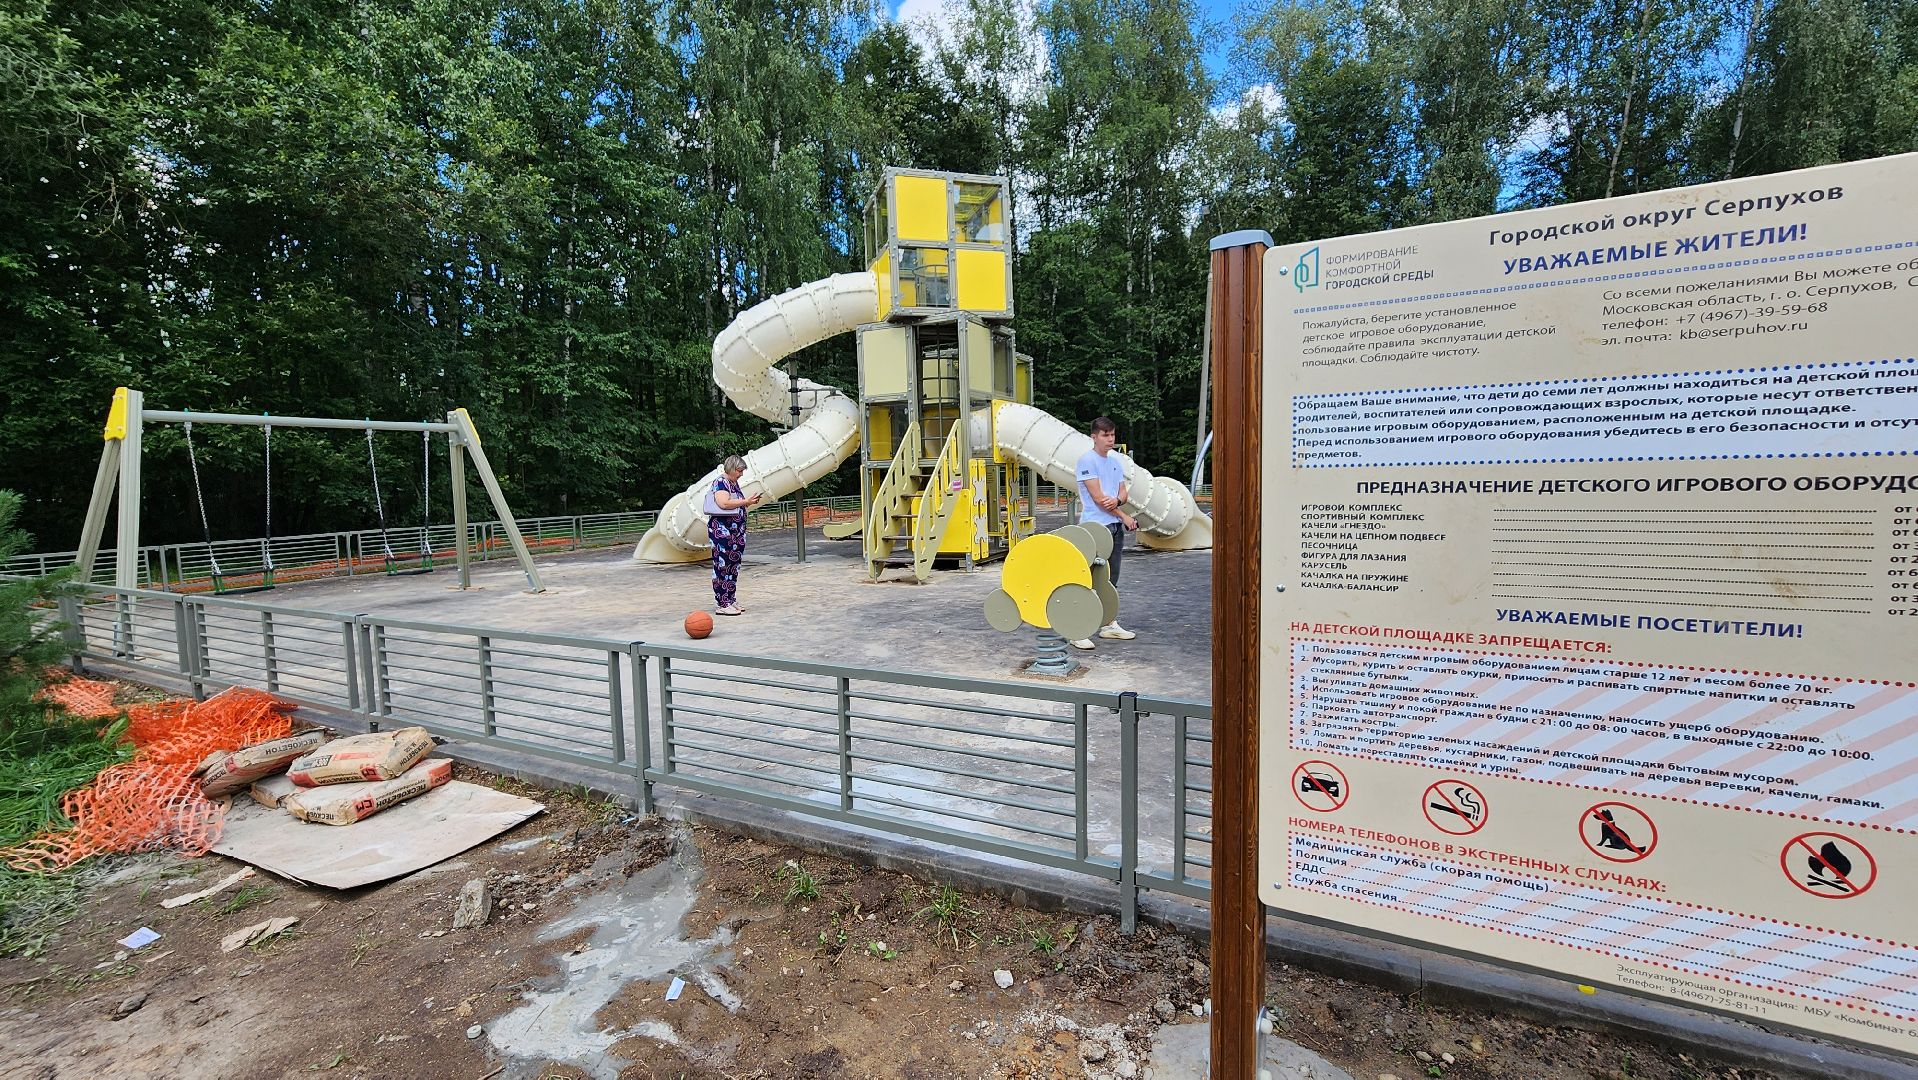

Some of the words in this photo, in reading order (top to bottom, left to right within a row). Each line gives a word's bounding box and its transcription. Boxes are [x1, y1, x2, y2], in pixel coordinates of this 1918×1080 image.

[1490, 214, 1614, 246] Городской
[1623, 207, 1696, 228] округ
[1705, 186, 1843, 217] Серпухов
[1326, 244, 1418, 265] ФОРМИРОВАНИЕ
[1503, 240, 1668, 275] УВАЖАЕМЫЕ
[1674, 223, 1806, 256] ЖИТЕЛИ!
[1325, 258, 1401, 278] КОМФОРТНОЙ
[1326, 272, 1390, 290] ГОРОДСКОЙ
[1393, 269, 1434, 282] СРЕДЫ
[1603, 290, 1622, 301] Со
[1626, 286, 1671, 299] всеми
[1676, 274, 1789, 294] пожеланиями
[1794, 270, 1817, 282] Вы
[1822, 264, 1892, 279] можете
[1602, 300, 1693, 316] Московская
[1697, 294, 1766, 307] область,
[1805, 280, 1897, 298] Серпухов,
[1302, 317, 1369, 330] Пожалуйста,
[1370, 312, 1422, 324] берегите
[1424, 302, 1517, 321] установленное
[1602, 317, 1668, 331] телефон:
[1676, 313, 1696, 324] +7
[1700, 301, 1828, 324] (4967)-39-59-68
[1302, 332, 1345, 344] детское
[1349, 327, 1395, 340] игровое
[1397, 319, 1486, 334] оборудование,
[1302, 342, 1366, 355] соблюдайте
[1367, 339, 1415, 352] правила
[1420, 331, 1502, 345] эксплуатации
[1505, 325, 1556, 340] детской
[1601, 337, 1621, 346] эл.
[1624, 333, 1672, 344] почта:
[1680, 322, 1808, 340] kb@serpuhov.ru
[1302, 357, 1358, 367] площадки.
[1359, 350, 1429, 363] Соблюдайте
[1431, 347, 1480, 357] чистоту.
[1298, 400, 1358, 411] Обращаем
[1361, 398, 1392, 406] Ваше
[1395, 394, 1460, 404] внимание,
[1487, 391, 1519, 401] дети
[1521, 390, 1540, 400] до
[1542, 388, 1577, 397] семи
[1579, 386, 1604, 395] лет
[1606, 383, 1669, 395] должны
[1673, 377, 1768, 390] находиться
[1773, 375, 1793, 384] на
[1796, 370, 1870, 385] детской
[1298, 411, 1361, 424] родителей,
[1364, 406, 1446, 419] воспитателей
[1449, 407, 1473, 415] или
[1475, 400, 1602, 415] сопровождающих
[1605, 397, 1684, 410] взрослых,
[1687, 393, 1759, 404] которые
[1763, 390, 1811, 402] несут
[1298, 425, 1371, 435] пользование
[1374, 422, 1428, 433] игровым
[1431, 418, 1540, 431] оборудованием,
[1543, 412, 1665, 427] расположенным
[1669, 411, 1688, 420] на
[1691, 406, 1757, 421] детской
[1762, 404, 1856, 416] площадке.
[1298, 438, 1333, 448] Перед
[1334, 436, 1434, 446] использованием
[1437, 433, 1497, 444] игрового
[1499, 430, 1601, 441] оборудования
[1603, 426, 1683, 439] убедитесь
[1686, 426, 1696, 434] в
[1699, 425, 1725, 434] его
[1729, 421, 1849, 432] безопасности
[1854, 420, 1866, 428] и
[1298, 451, 1362, 461] предметов.
[1357, 480, 1534, 496] ПРЕДНАЗНАЧЕНИЕ
[1538, 478, 1650, 495] ДЕТСКОГО
[1656, 477, 1787, 492] ИГРОВОГО
[1300, 512, 1366, 521] СПОРТИВНЫЙ
[1370, 513, 1425, 521] КОМПЛЕКС
[1301, 504, 1345, 512] ИГРОВОЙ
[1348, 504, 1402, 512] КОМПЛЕКС
[1301, 532, 1338, 540] КАЧЕЛИ
[1339, 532, 1353, 540] НА
[1355, 532, 1398, 541] ЦЕПНОМ
[1340, 522, 1386, 531] «ГНЕЗДО»
[1300, 552, 1338, 560] ФИГУРА
[1338, 552, 1358, 561] ДЛЯ
[1360, 553, 1406, 562] ЛАЗАНИЯ
[1301, 541, 1358, 552] ПЕСОЧНИЦА
[1300, 571, 1344, 580] КАЧАЛКА
[1361, 574, 1408, 582] ПРУЖИНЕ
[1301, 562, 1348, 570] КАРУСЕЛЬ
[1301, 581, 1399, 592] КАЧАЛКА-БАЛАНСИР
[1496, 608, 1631, 628] УВАЖАЕМЫЕ
[1637, 616, 1802, 638] ПОСЕТИТЕЛИ!
[1291, 621, 1310, 632] НА
[1312, 623, 1380, 637] ДЕТСКОЙ
[1384, 628, 1474, 645] ПЛОЩАДКЕ
[1478, 634, 1612, 654] ЗАПРЕЩАЕТСЯ:
[1312, 645, 1378, 658] Пользоваться
[1379, 652, 1420, 661] детским
[1422, 656, 1469, 665] игровым
[1472, 658, 1560, 672] оборудованием
[1562, 667, 1600, 676] лицам
[1602, 670, 1648, 680] старше
[1651, 672, 1666, 681] 12
[1705, 678, 1745, 687] весом
[1748, 679, 1790, 691] более
[1794, 683, 1812, 693] 70
[1814, 686, 1832, 694] кг.
[265, 738, 318, 755] ПЕСКОБЕТОН
[400, 740, 428, 767] ПЕСКОБЕТОН
[356, 799, 373, 813] СМ
[376, 783, 427, 808] ПЕСКОБЕТОН
[1289, 816, 1346, 835] НОМЕРА
[1349, 827, 1440, 852] ТЕЛЕФОНОВ
[1445, 844, 1454, 854] В
[1458, 846, 1570, 875] ЭКСТРЕННЫХ
[1575, 867, 1666, 893] СЛУЧАЯХ:
[1295, 836, 1377, 860] Медицинская
[1380, 855, 1426, 869] служба
[1430, 862, 1481, 879] (скорая
[1485, 874, 1549, 893] помощь)
[1296, 849, 1347, 866] Полиция
[1295, 861, 1326, 875] ЕДДС
[1294, 873, 1338, 890] Служба
[1341, 885, 1397, 902] спасения
[1616, 973, 1665, 992] Телефон:
[1670, 986, 1766, 1014] 8-(4967)-75-81-11
[1616, 963, 1716, 993] Эксплуатирующая
[1718, 988, 1798, 1011] организация:
[1804, 1005, 1831, 1018] МБУ
[1834, 1013, 1906, 1034] «Комбинат
